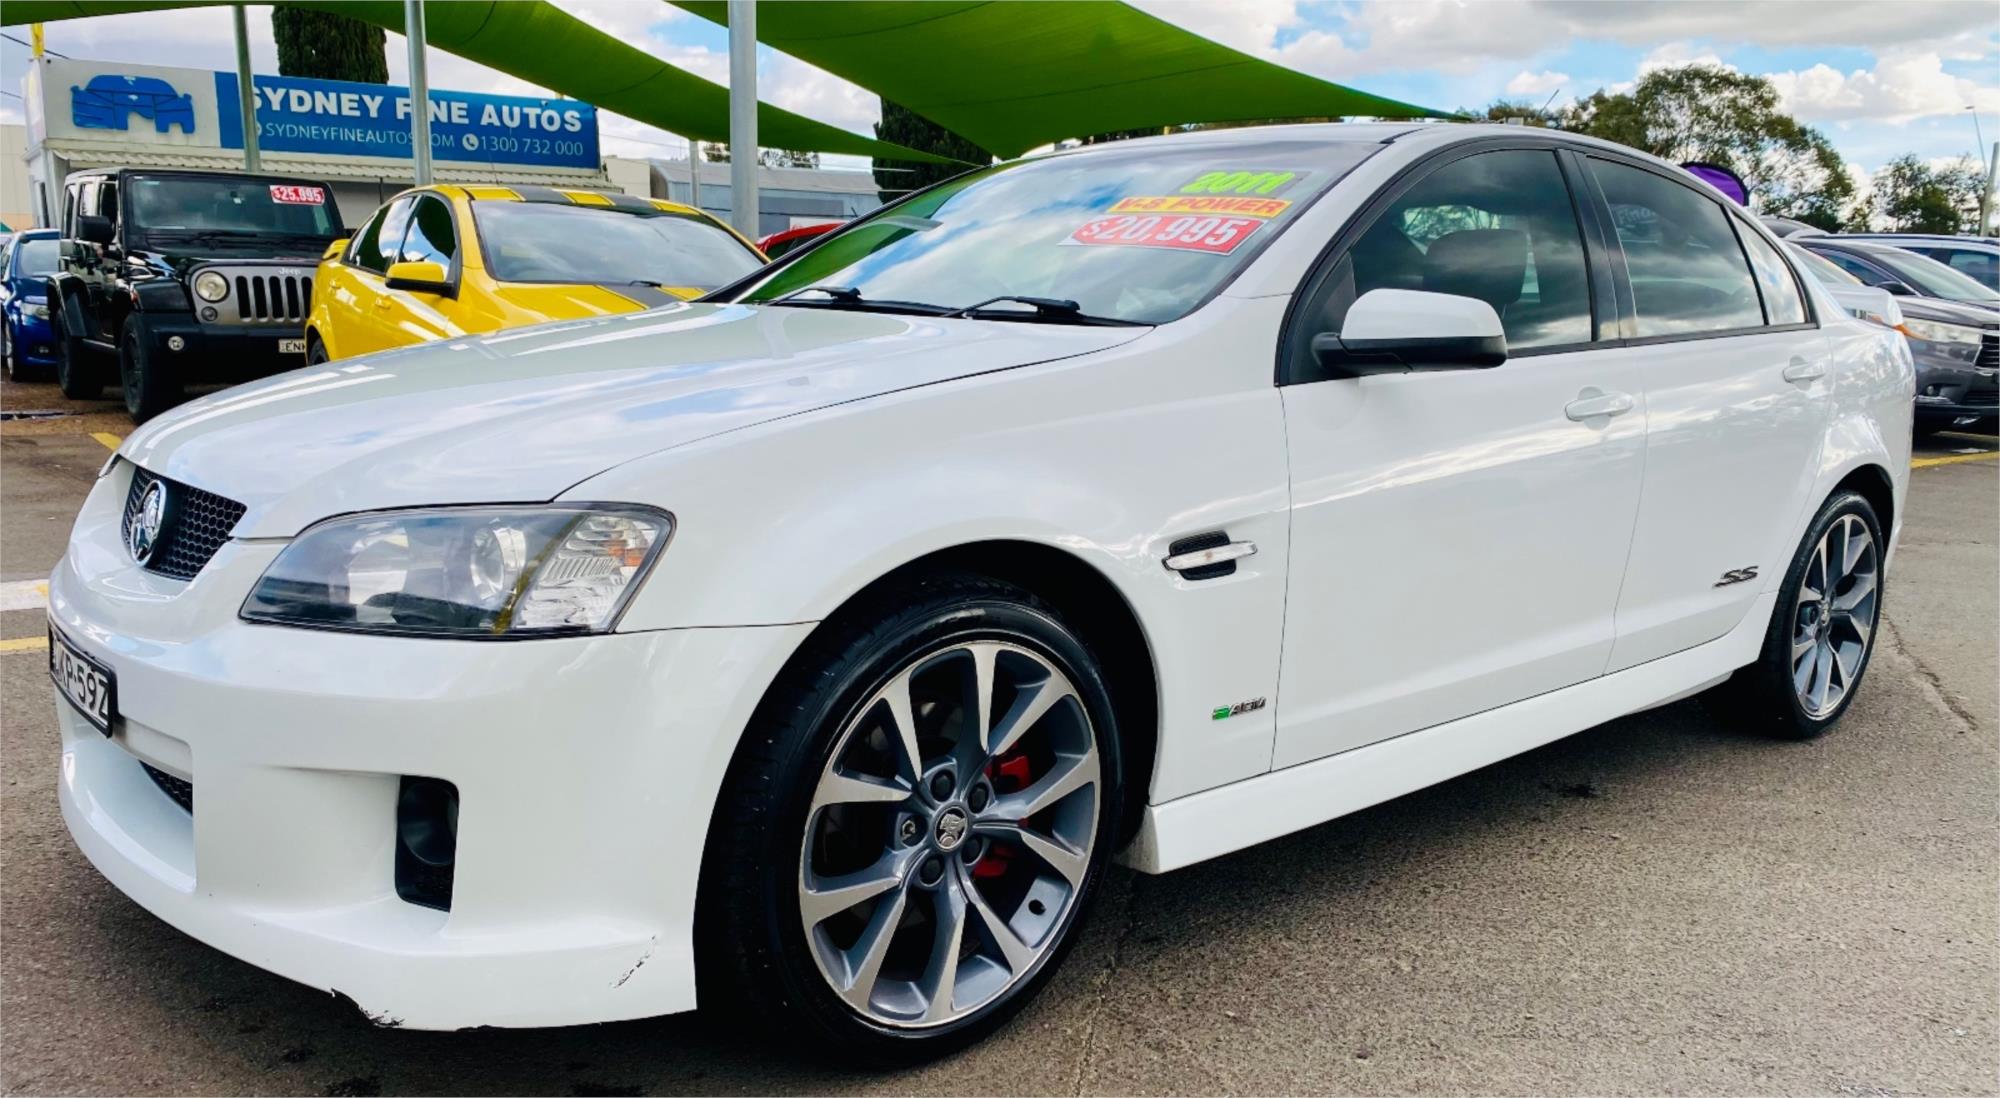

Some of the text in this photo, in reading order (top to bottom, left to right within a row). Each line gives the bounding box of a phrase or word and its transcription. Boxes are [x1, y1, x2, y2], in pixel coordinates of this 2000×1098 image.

[395, 97, 470, 125] FNE
[480, 104, 583, 132] AUTOS
[481, 136, 518, 152] 1300
[523, 138, 550, 154] 732
[555, 140, 583, 156] 000
[1181, 171, 1296, 194] 2011
[1173, 198, 1283, 213] POWER
[1082, 216, 1249, 246] $20,995
[1714, 565, 1759, 587] SS
